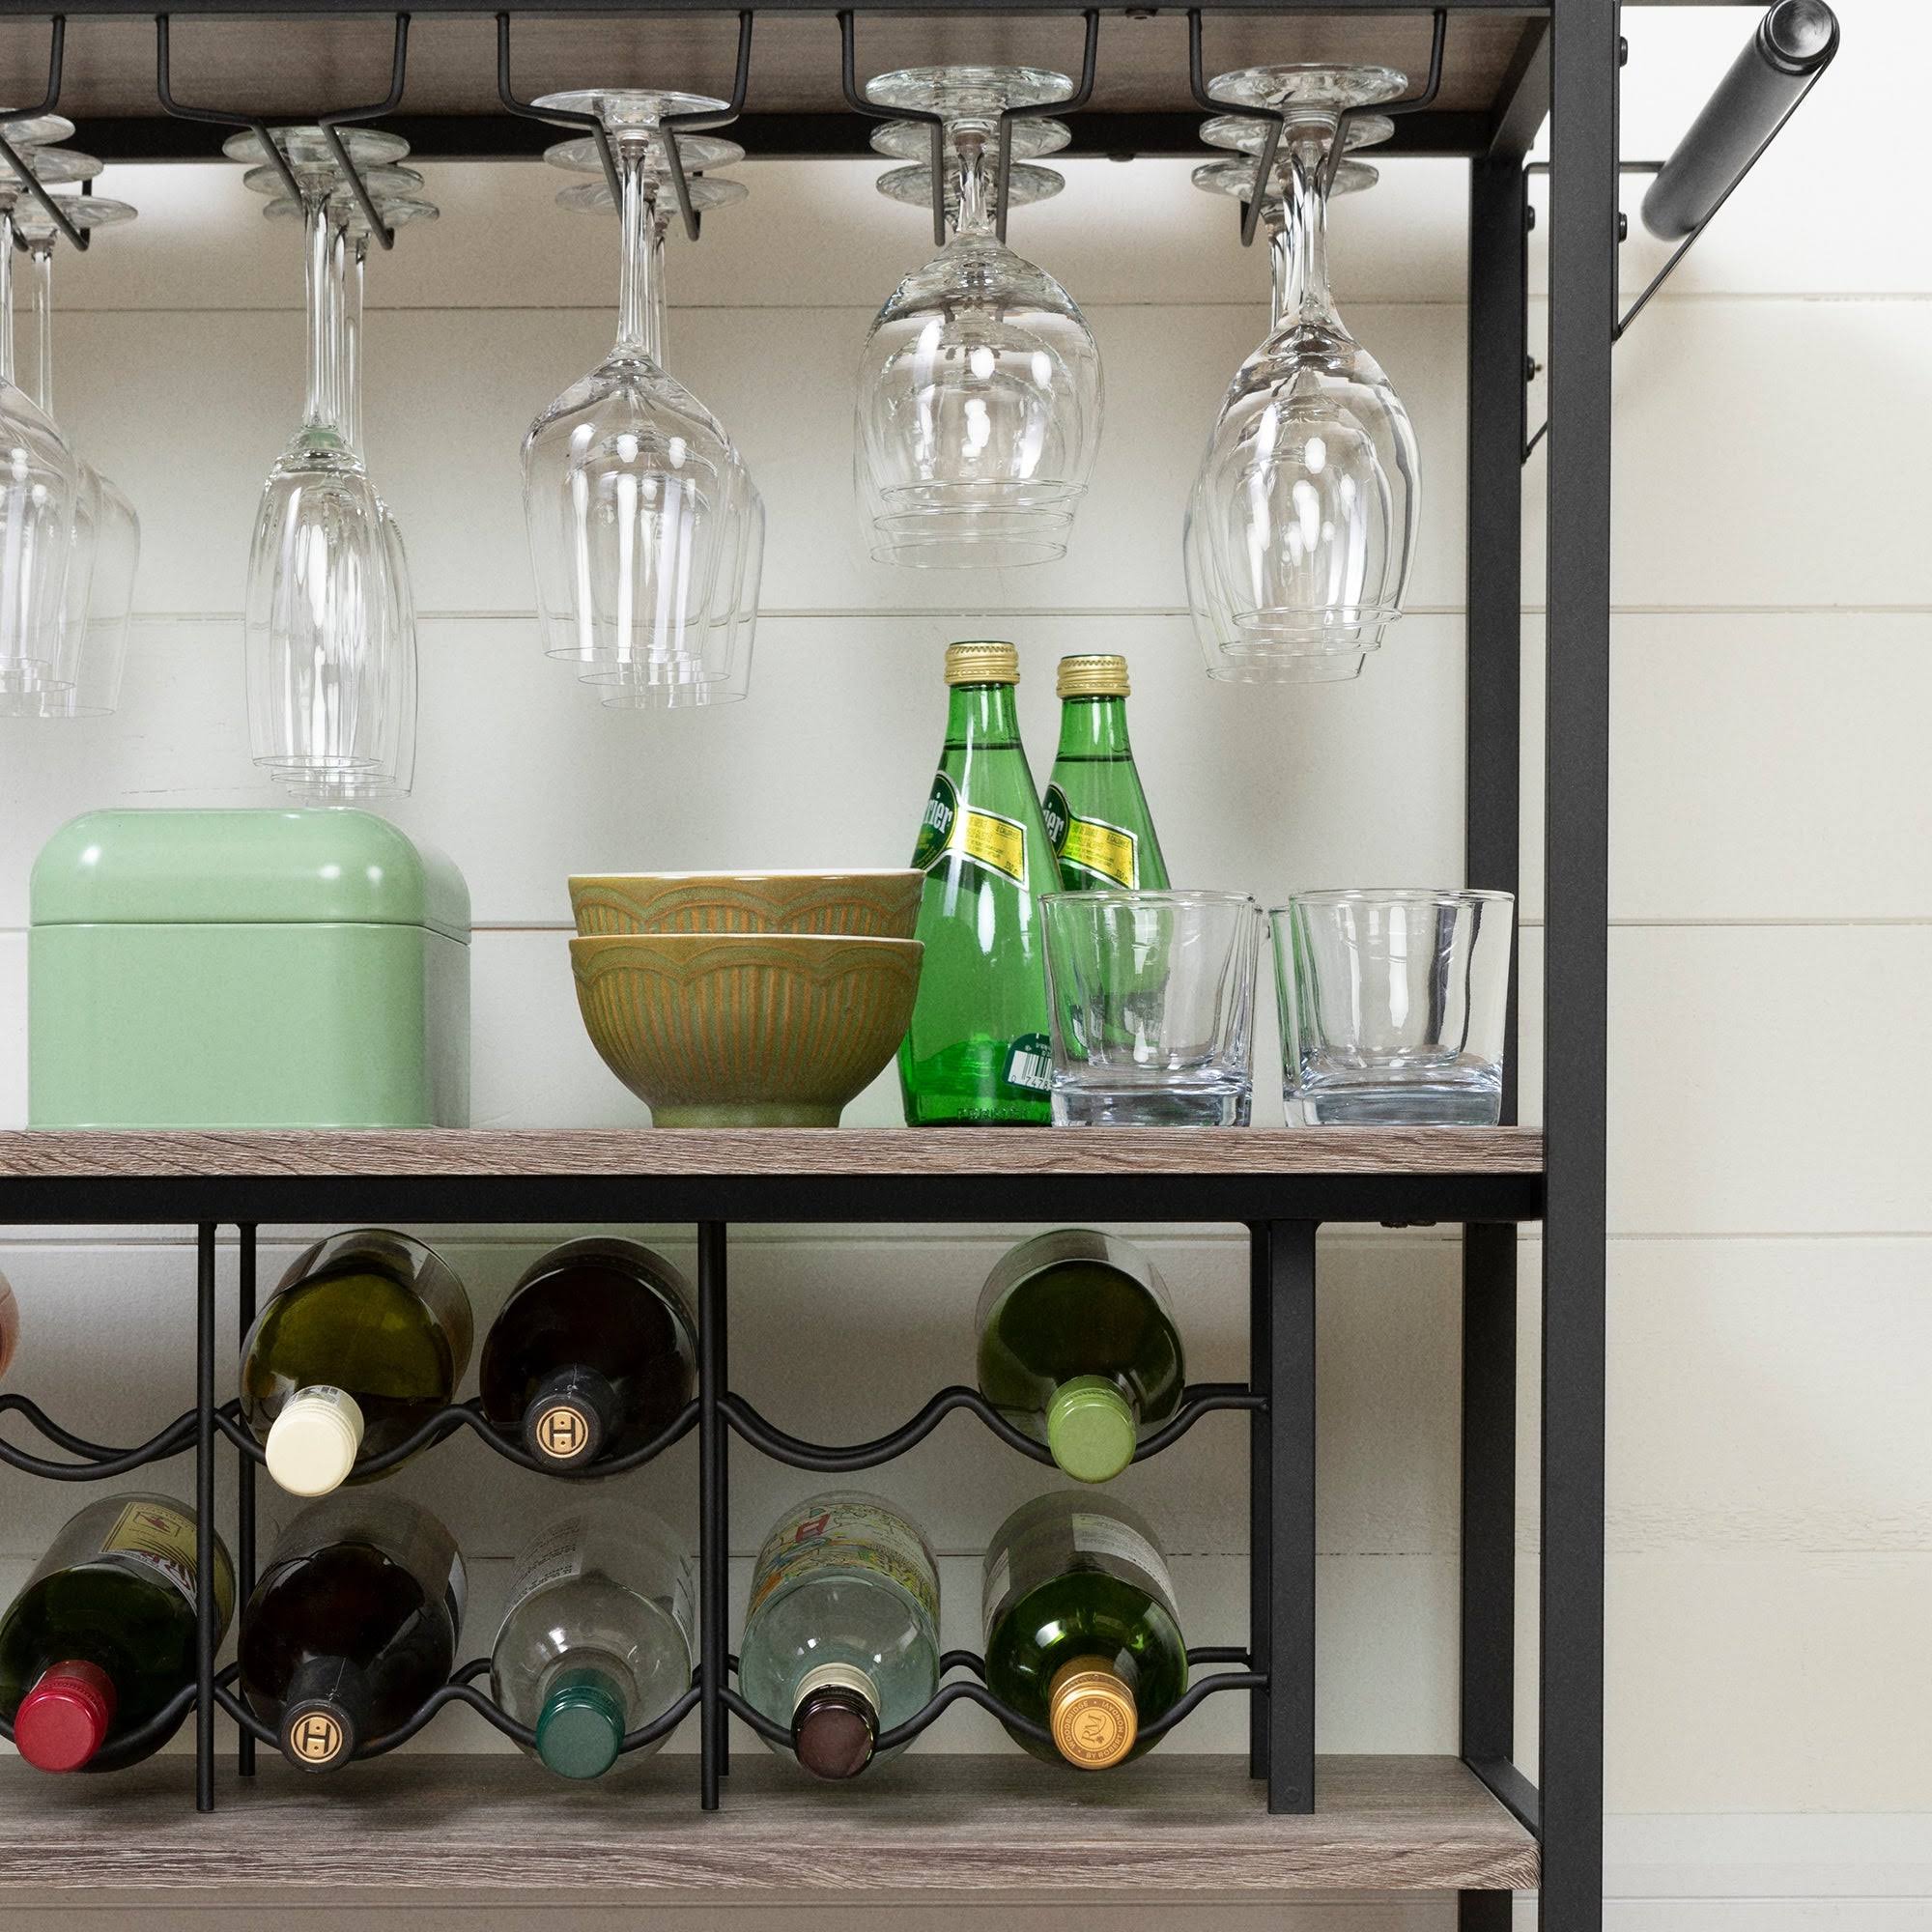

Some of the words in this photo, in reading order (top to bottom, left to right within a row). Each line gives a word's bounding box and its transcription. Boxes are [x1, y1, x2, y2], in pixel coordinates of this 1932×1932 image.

[922, 792, 953, 834] rier
[1042, 802, 1065, 842] ier
[1063, 1700, 1090, 1749] WOODBRIDGE
[1101, 1700, 1124, 1734] MONDAVI
[1098, 1734, 1123, 1759] ROBERT
